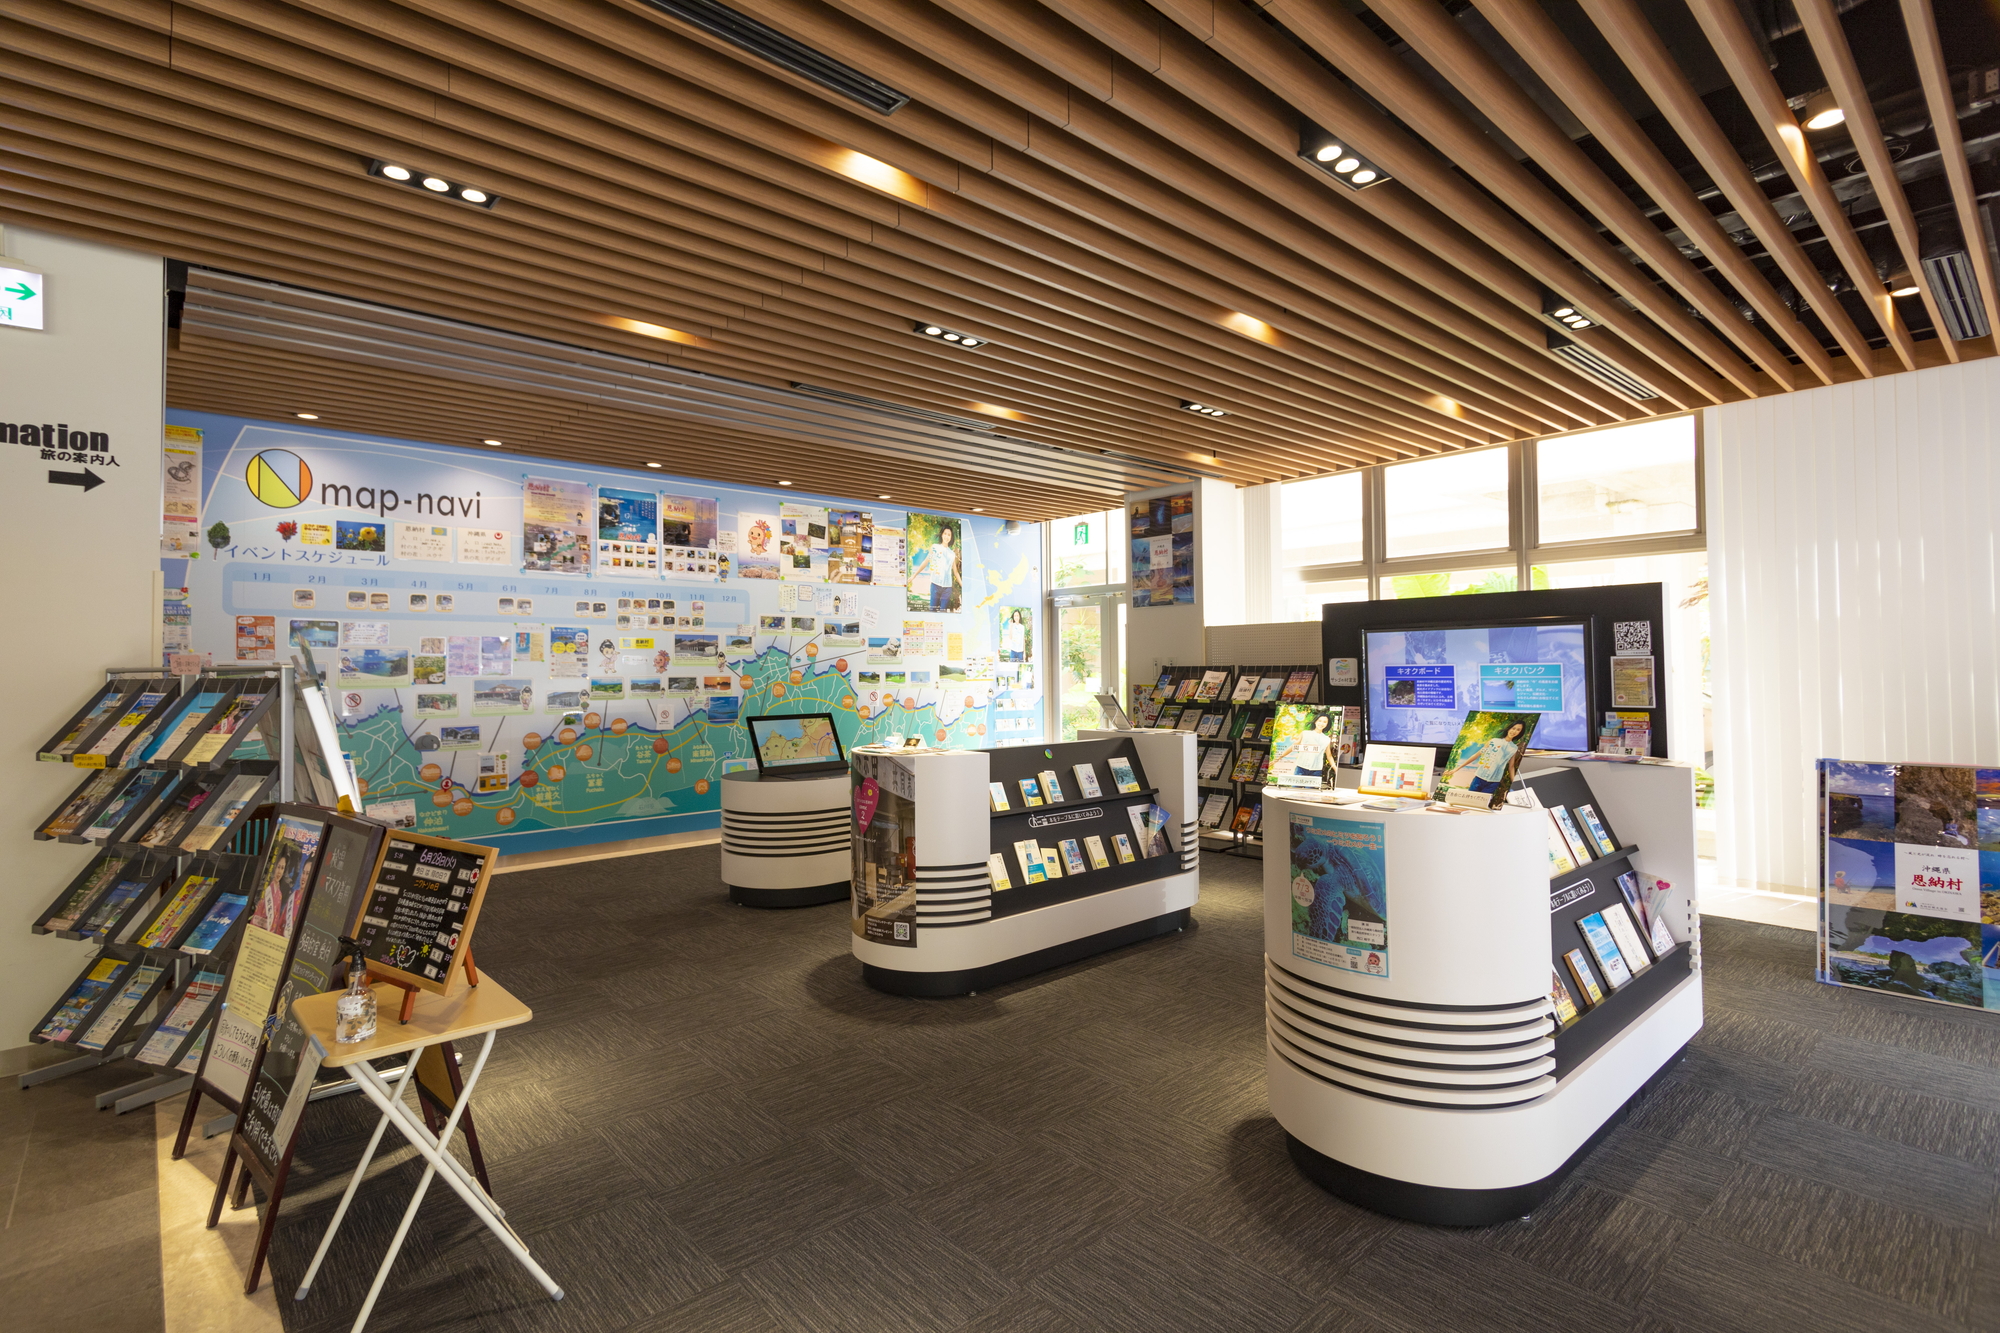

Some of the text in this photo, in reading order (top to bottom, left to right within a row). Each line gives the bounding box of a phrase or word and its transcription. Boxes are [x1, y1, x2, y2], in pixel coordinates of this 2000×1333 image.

[40, 448, 120, 467] 旅の案内人
[321, 483, 481, 518] map-navi
[224, 545, 391, 566] イベントスケジュール
[253, 572, 271, 582] 1月
[308, 575, 326, 584] 2月
[361, 577, 378, 587] 3月
[411, 580, 427, 589] 4月
[458, 582, 473, 591] 5月
[502, 584, 517, 593] 6月
[544, 587, 558, 595] 7月
[584, 588, 597, 597] 8月
[621, 590, 634, 598] 9月
[1397, 667, 1441, 675] キオクボード
[1494, 666, 1545, 675] キオクバンク
[424, 816, 443, 826] 仲泊
[418, 825, 450, 833] Nakadomari
[420, 849, 457, 869] 6月28日(火)
[1922, 865, 1951, 875] 沖縄県
[1296, 882, 1310, 893] 7/3
[1911, 874, 1963, 891] 恩納村
